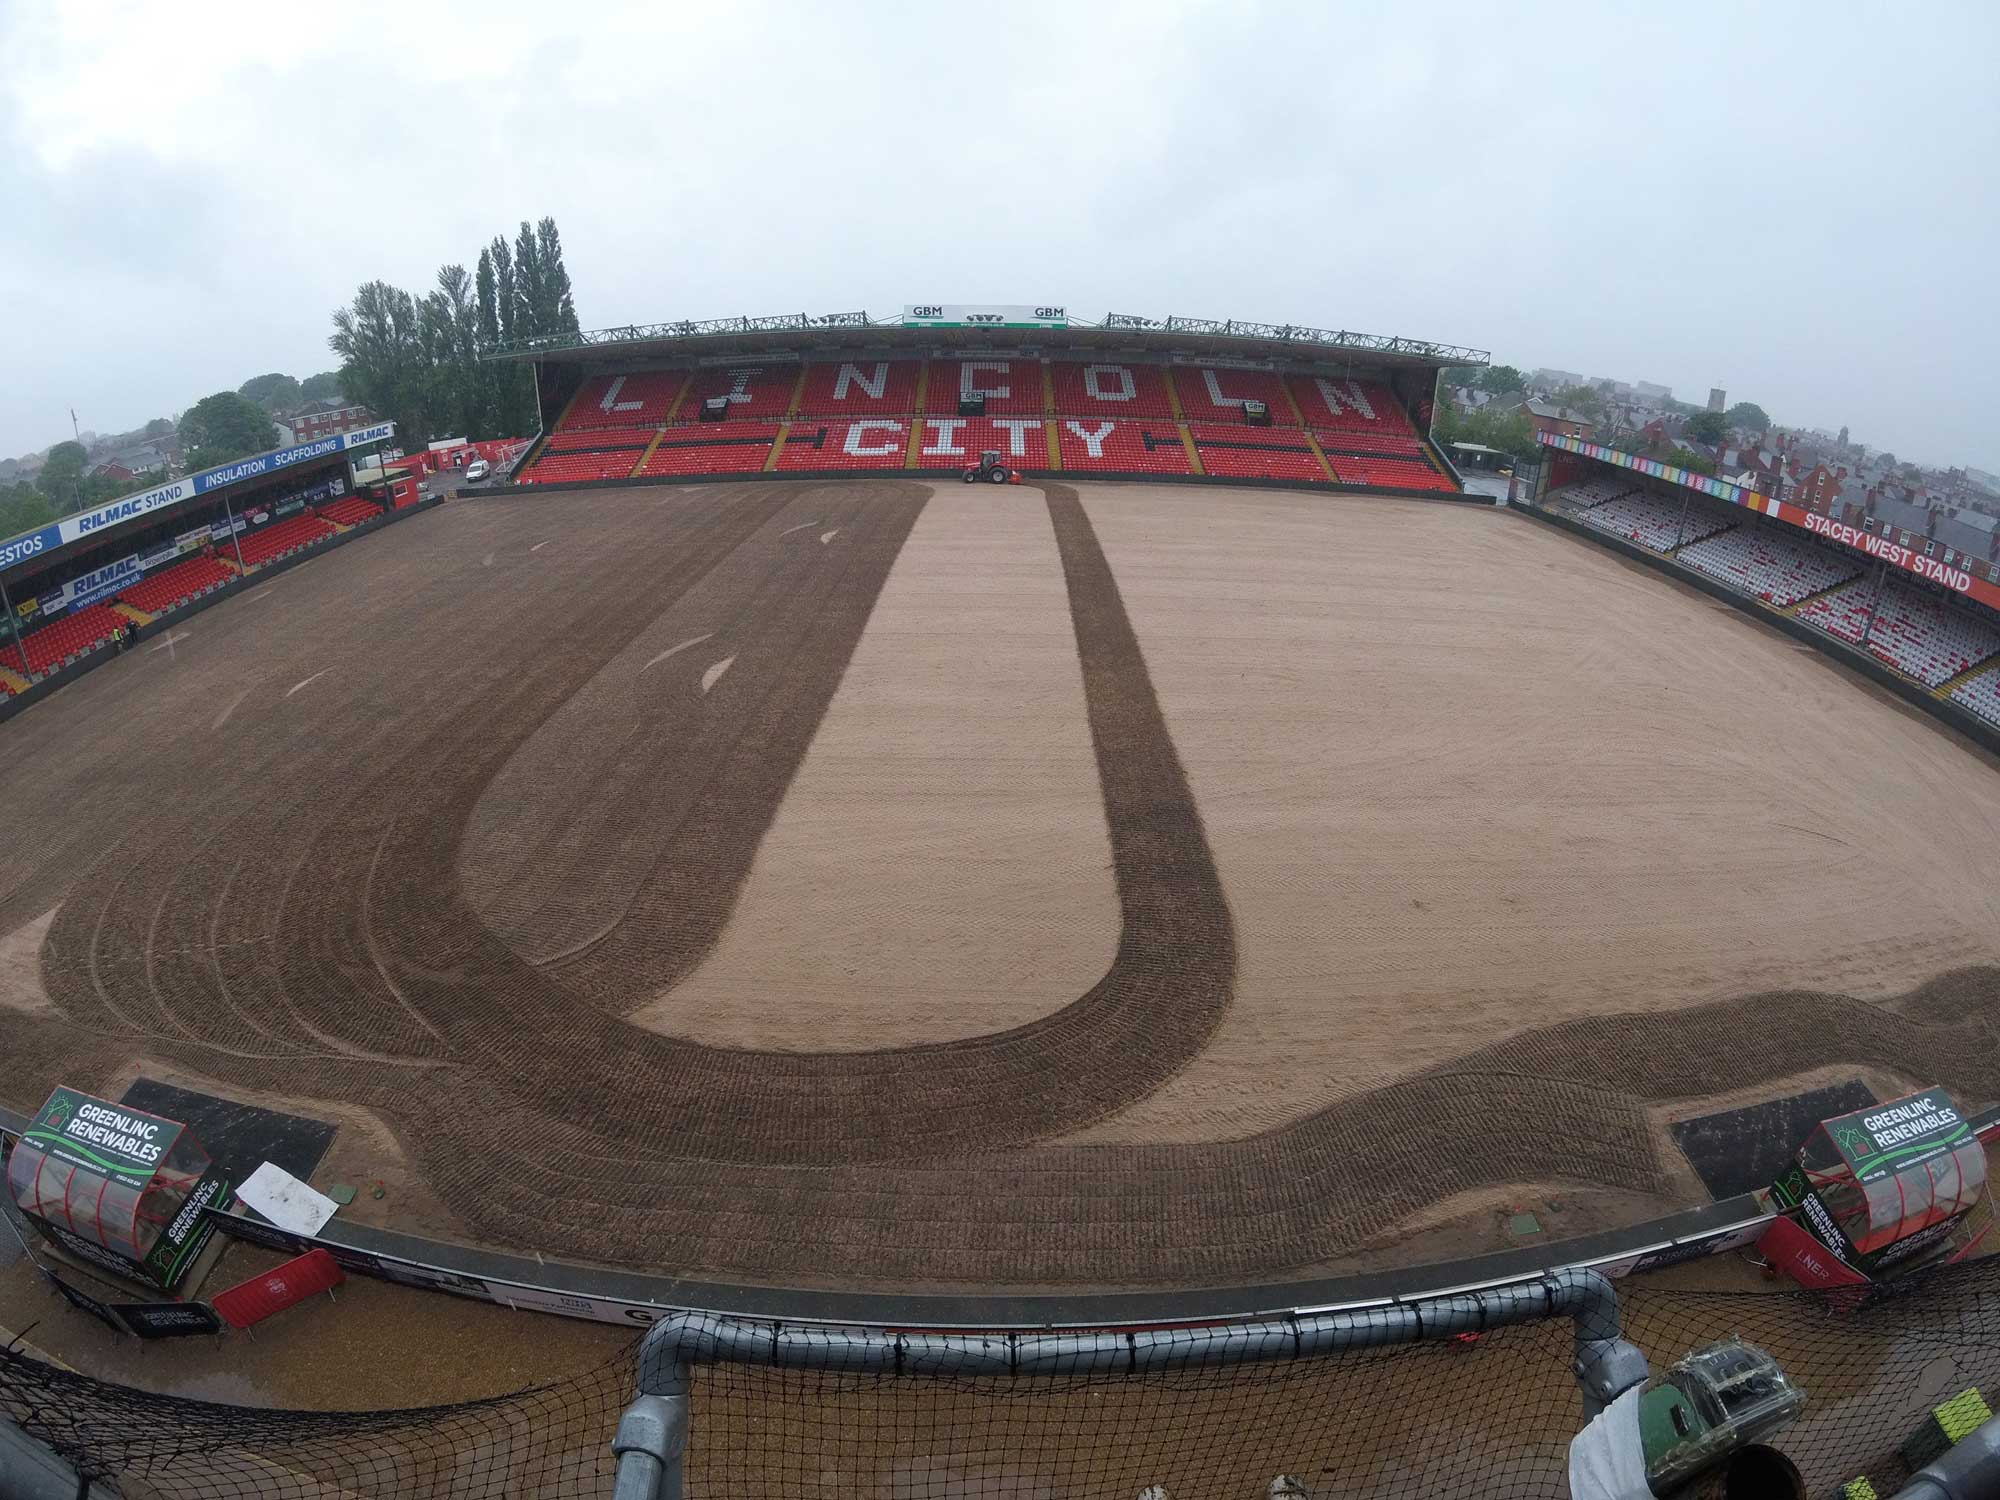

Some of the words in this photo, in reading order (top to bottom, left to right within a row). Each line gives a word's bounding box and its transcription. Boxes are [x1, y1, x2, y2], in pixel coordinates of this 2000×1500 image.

[913, 306, 942, 316] GBM
[1035, 307, 1064, 317] GBM
[600, 360, 1376, 420] LINCOLN
[351, 425, 389, 445] RILMAC
[843, 419, 1117, 459] CITY
[205, 459, 266, 488] INSULATION
[275, 439, 336, 466] SCAFFOLDING
[79, 499, 142, 534] RILMAC
[145, 485, 183, 509] STAND
[1804, 512, 1864, 546] STACEY
[1865, 534, 1911, 567] WEST
[1913, 555, 1971, 592] STAND
[73, 557, 137, 596] RILMAC
[78, 1103, 159, 1140] GREENLINC
[1863, 1097, 1936, 1132] GREENLINC
[1873, 1107, 1957, 1147] RENEWABLES
[66, 1118, 162, 1162] RENEWABLES
[168, 1181, 209, 1238] GREENLINC
[173, 1179, 219, 1245] RENEWABLES
[1801, 1198, 1847, 1262] RENEWABLES
[1807, 1192, 1846, 1248] GREENLINC
[1795, 1249, 1830, 1280] LNER
